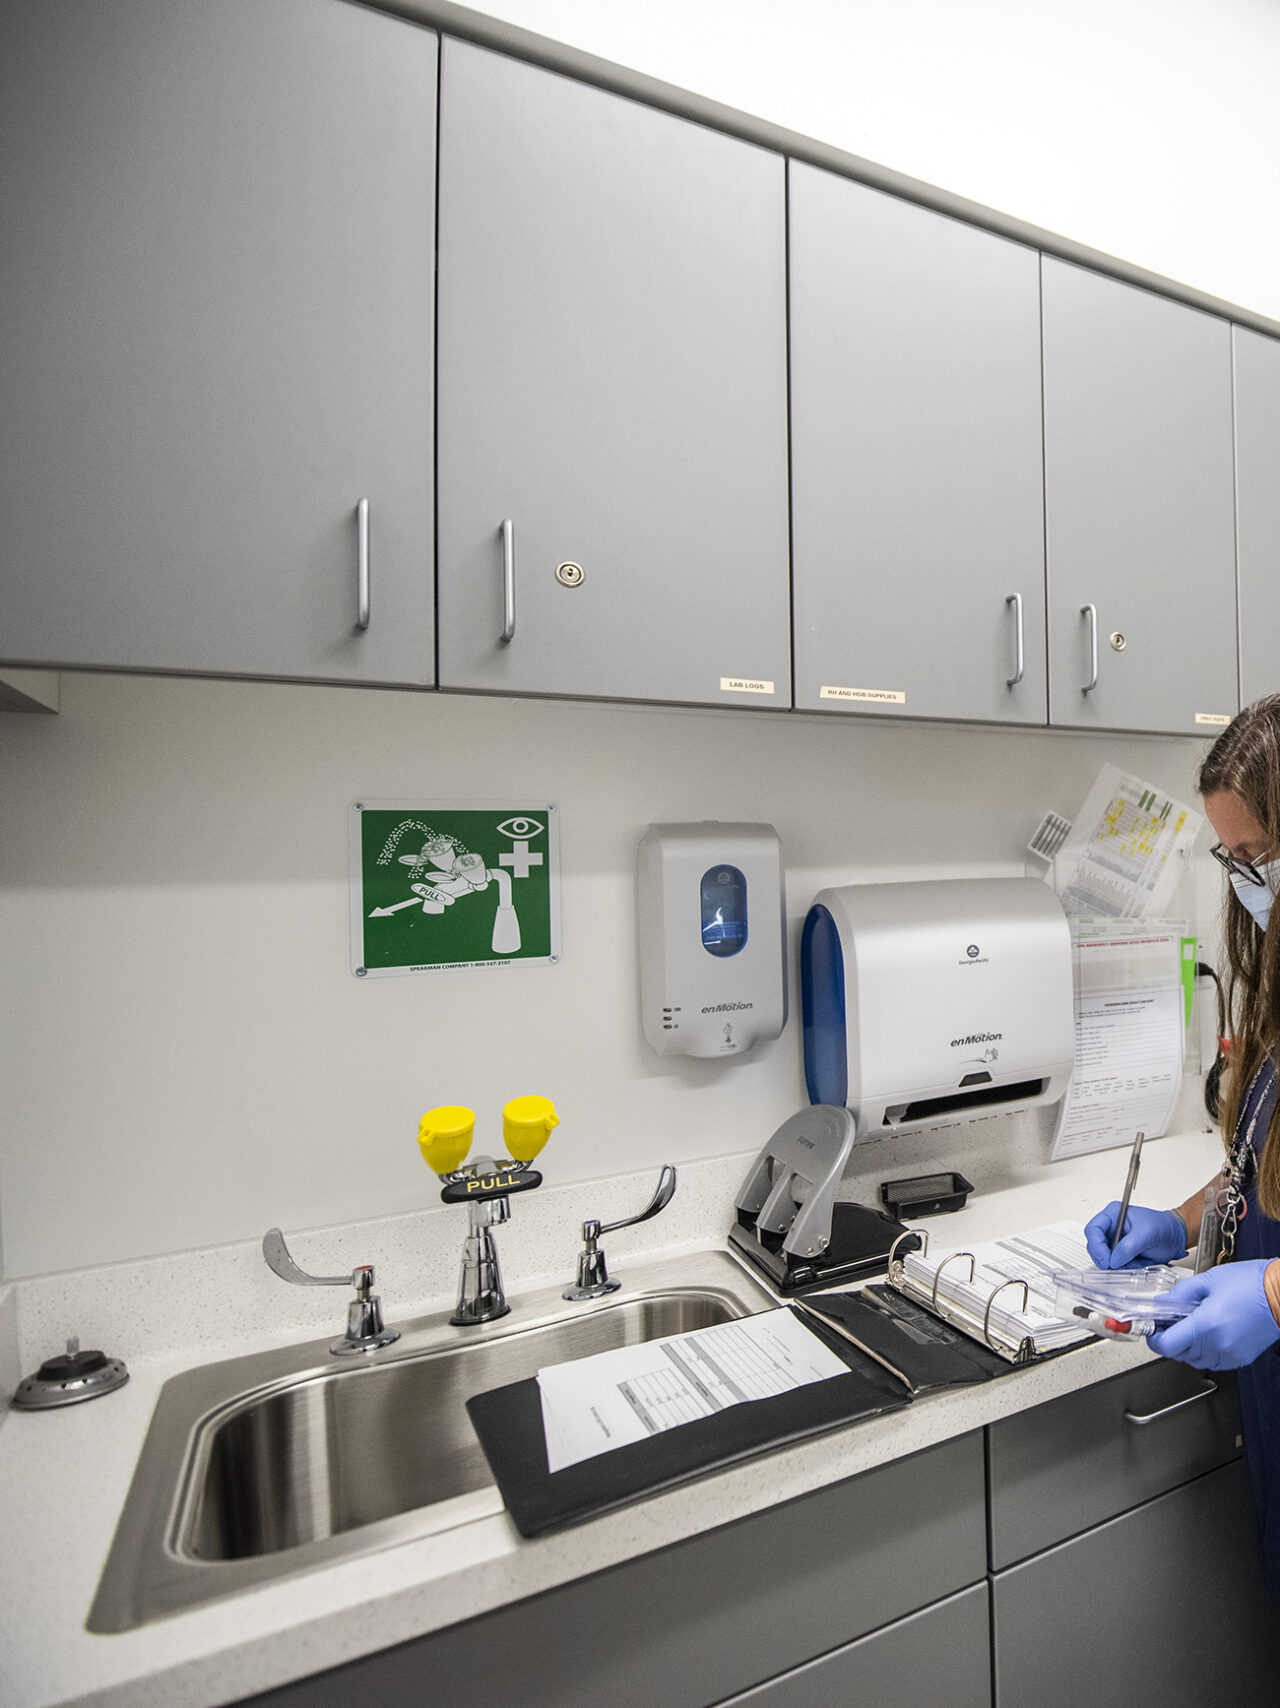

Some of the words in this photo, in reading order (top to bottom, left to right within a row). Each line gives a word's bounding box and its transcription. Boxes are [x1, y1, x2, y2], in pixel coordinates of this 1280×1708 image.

[867, 692, 897, 700] SUPPLIES
[420, 886, 440, 901] PULL
[410, 964, 441, 972] SPEAKMAN
[701, 1001, 754, 1014] enMotion
[950, 1032, 1003, 1047] enMotion
[466, 1174, 521, 1193] PULL
